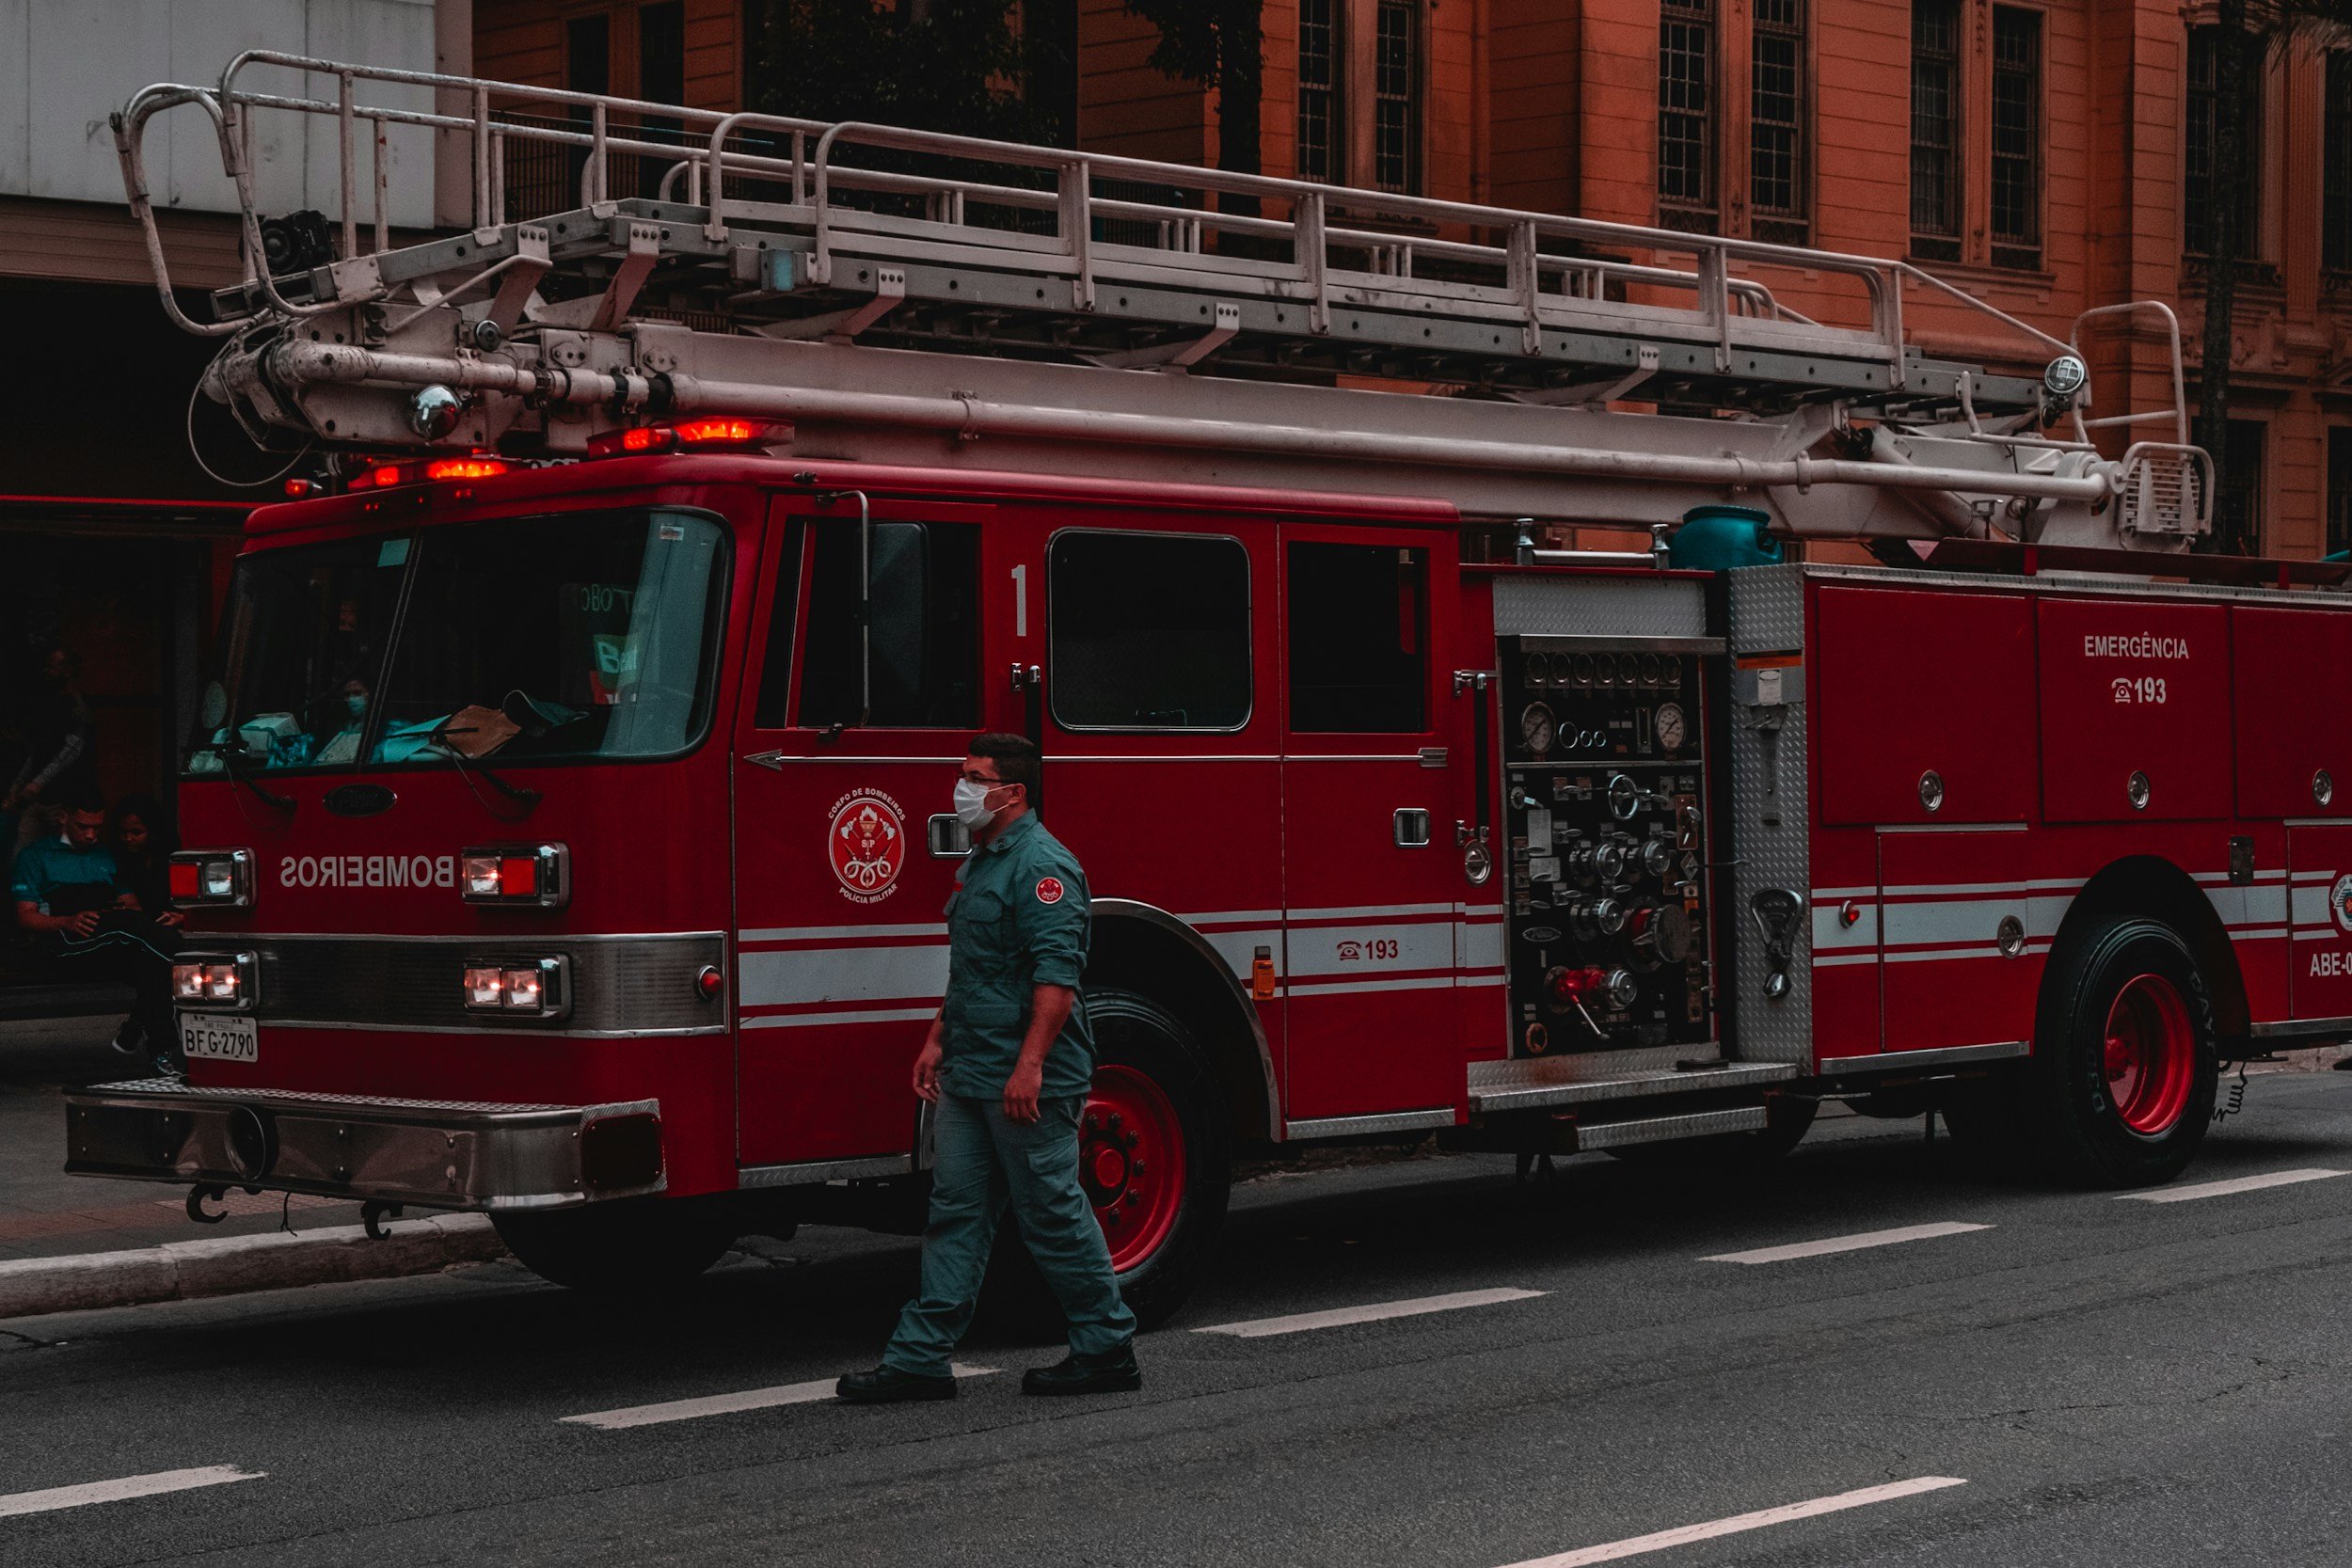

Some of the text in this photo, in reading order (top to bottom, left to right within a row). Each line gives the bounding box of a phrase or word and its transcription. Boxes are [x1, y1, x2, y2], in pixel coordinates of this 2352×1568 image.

[1011, 564, 1027, 637] 1
[2084, 630, 2190, 659] EMERGÊNCIA
[2134, 676, 2167, 704] 193
[828, 793, 850, 819] CORPO
[866, 788, 906, 821] BOMBEIROS
[839, 883, 898, 904] POLÍCIA MILITAR
[1365, 940, 1398, 960] 193
